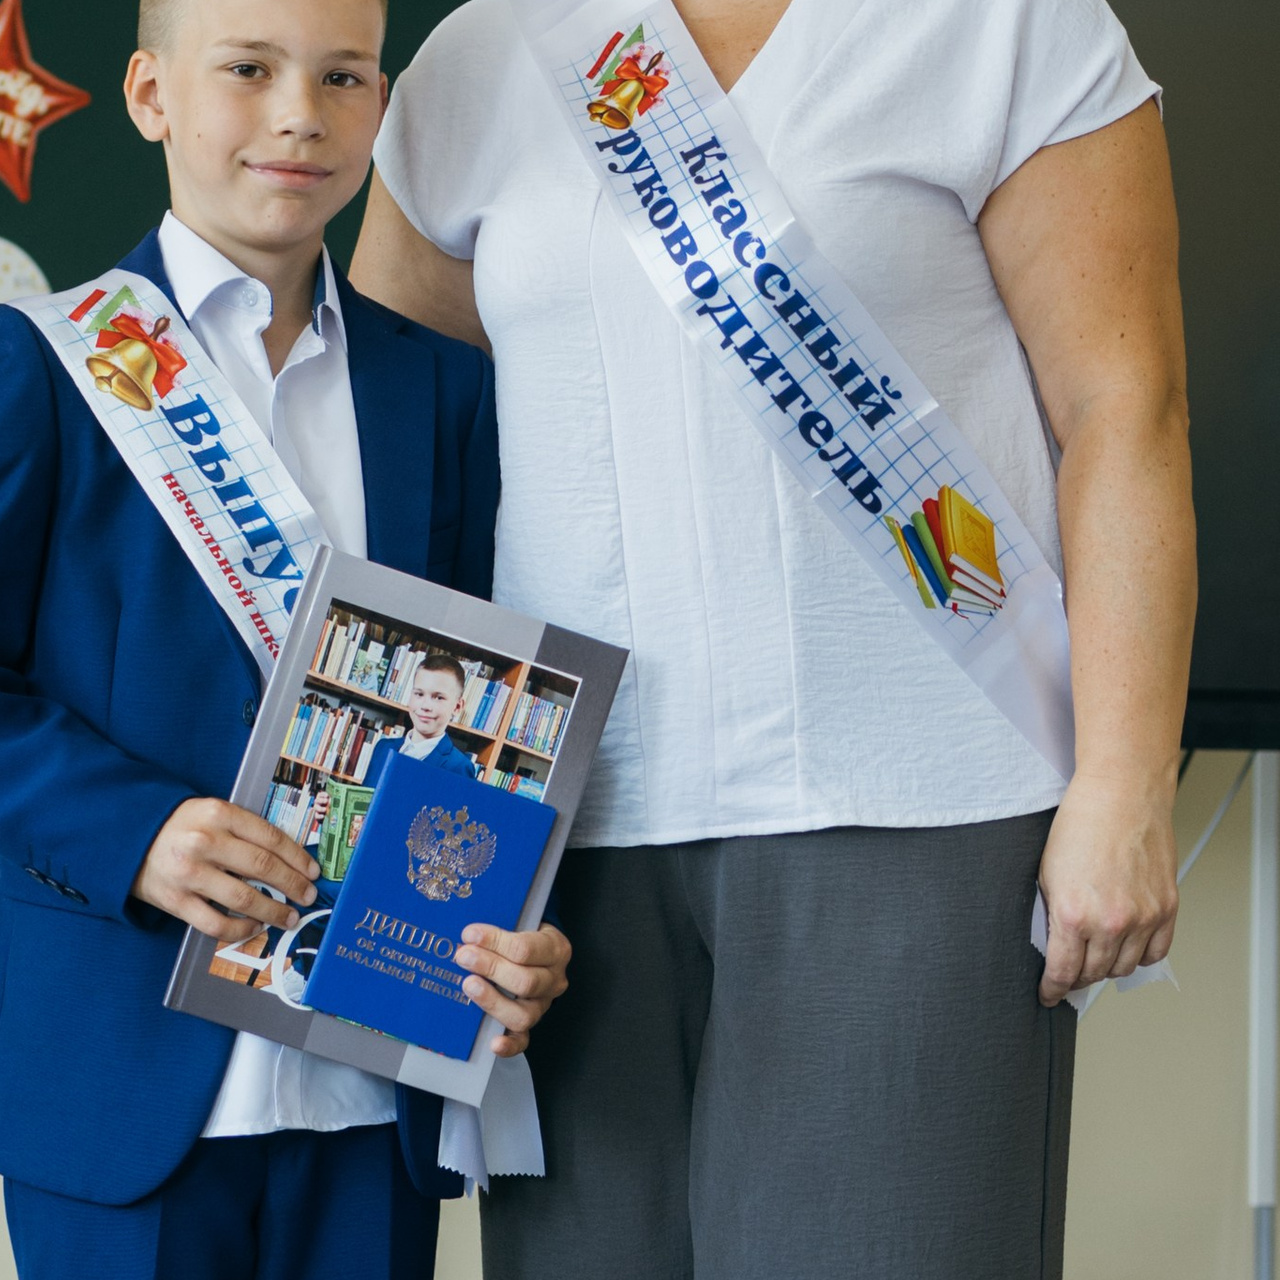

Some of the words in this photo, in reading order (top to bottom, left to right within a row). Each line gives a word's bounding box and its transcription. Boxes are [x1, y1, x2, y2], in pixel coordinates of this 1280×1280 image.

[595, 128, 885, 518] руководитель
[679, 135, 904, 432] Классный
[160, 471, 259, 609] начальной
[335, 944, 416, 985] НАЧАЛЬНОЙ
[354, 906, 462, 964] ДИПЛО
[355, 936, 376, 952] ОБ
[380, 944, 463, 986] ОКОНЧАНИИ
